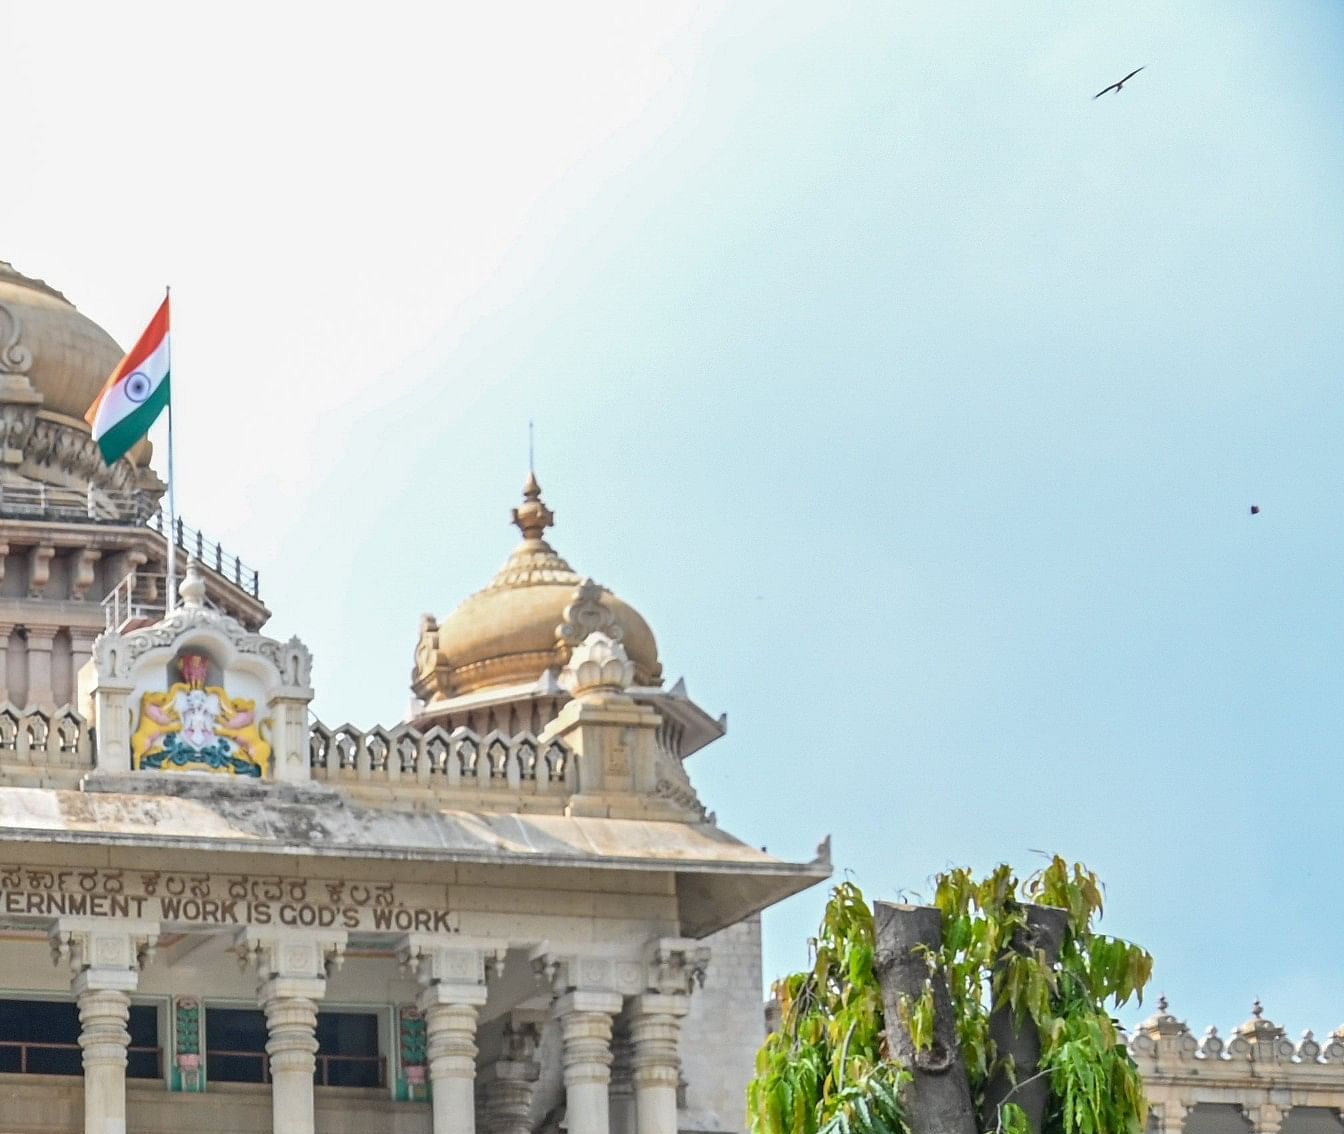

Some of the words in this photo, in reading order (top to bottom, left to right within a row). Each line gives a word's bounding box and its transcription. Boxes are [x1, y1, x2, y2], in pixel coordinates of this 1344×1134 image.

[161, 897, 238, 924] WORK
[246, 902, 272, 925] IS
[279, 904, 361, 928] GOD'S
[373, 908, 460, 933] WORK.
